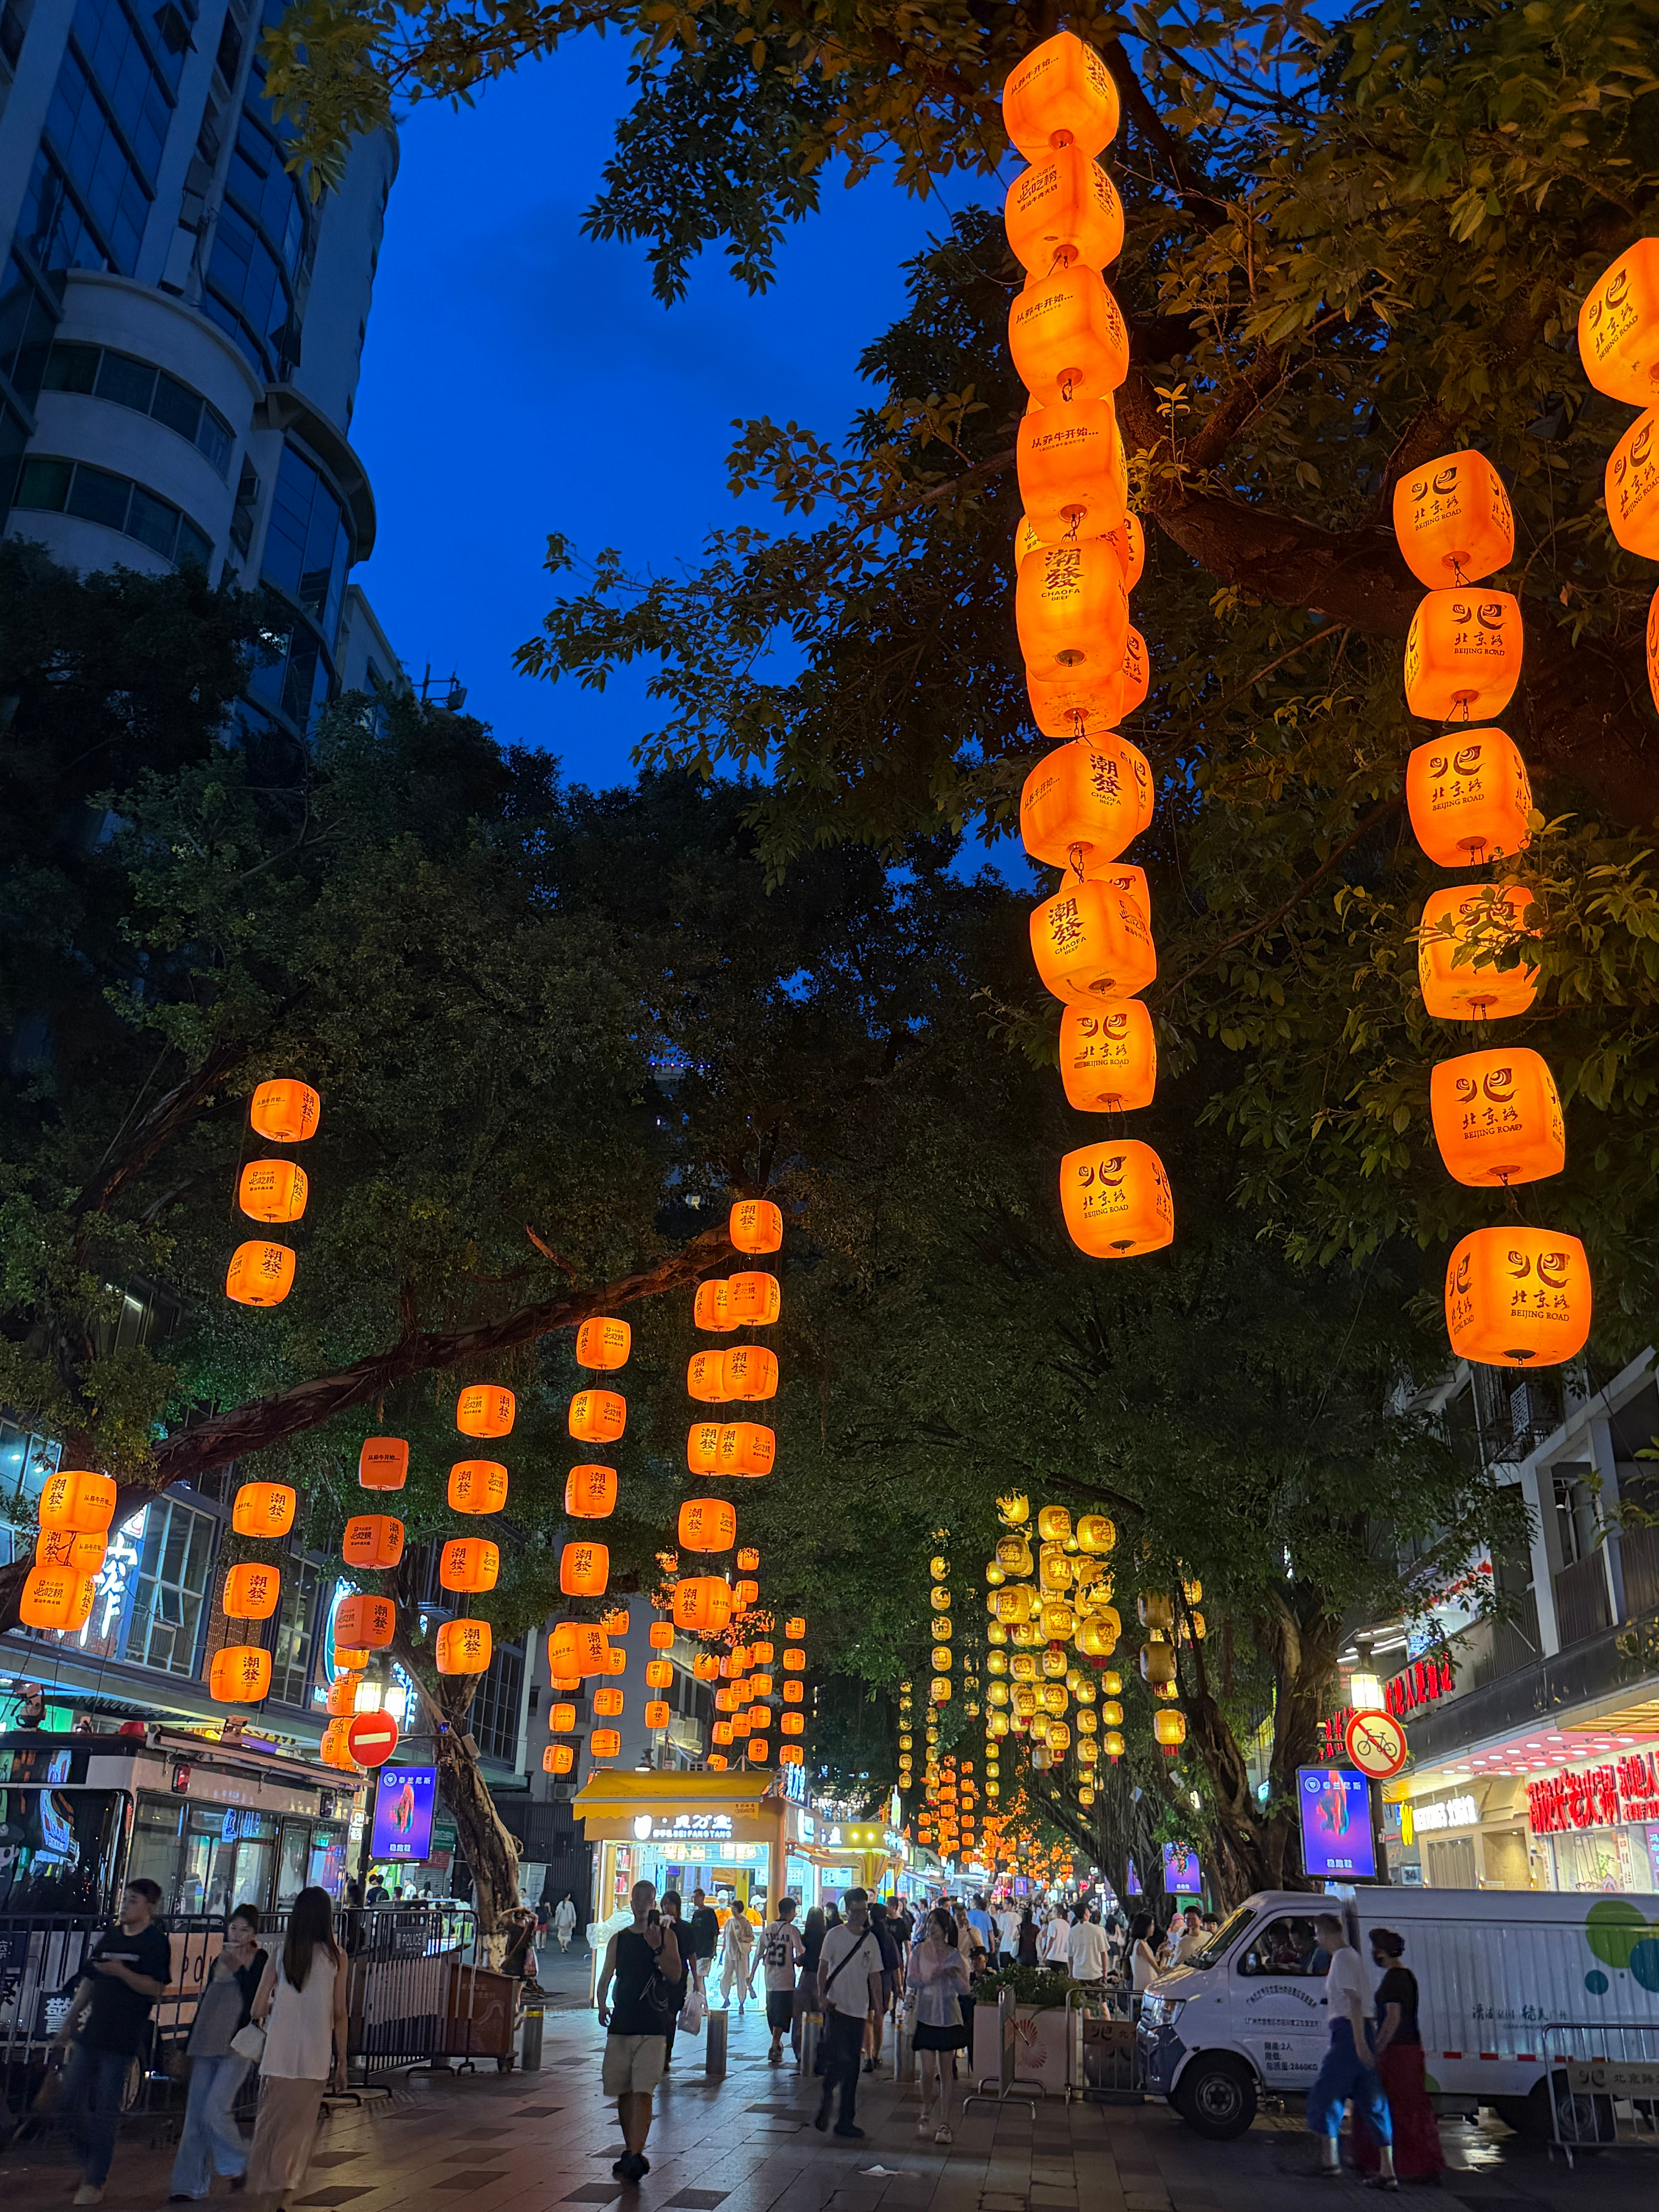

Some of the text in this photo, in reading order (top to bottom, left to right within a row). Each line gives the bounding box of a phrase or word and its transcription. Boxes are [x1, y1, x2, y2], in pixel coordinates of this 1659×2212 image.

[1017, 170, 1057, 204] 必吃榜
[1596, 302, 1633, 354] 北京路
[1598, 314, 1638, 361] BEIJING ROAD
[1620, 461, 1656, 514] 北京路
[1414, 495, 1459, 524] 北京路
[1623, 493, 1642, 521] BEIJING
[1415, 508, 1462, 531] BEIJING ROAD
[1042, 548, 1085, 590] 潮發
[1041, 589, 1080, 598] CHAOFA
[1454, 631, 1503, 647] 北京路
[1090, 753, 1123, 797] 潮發
[1091, 792, 1121, 805] CHAOFA
[1432, 778, 1483, 803] 北京路
[1432, 794, 1484, 811] BEIJING ROAD
[1048, 898, 1085, 945] 潮發
[1055, 936, 1086, 955] CHAOFA
[1065, 945, 1079, 955] BEEF
[1077, 1043, 1127, 1060] 北京路
[301, 1091, 314, 1118] 潮發
[1462, 1105, 1518, 1130] 北京路
[1464, 1124, 1523, 1140] BEIJING ROAD
[1083, 1189, 1126, 1210] 北京路
[740, 1205, 756, 1225] 潮發
[1084, 1208, 1108, 1219] BEIJING
[261, 1247, 282, 1274] 潮發
[1511, 1289, 1570, 1310] 北京路
[1510, 1309, 1570, 1322] BEIJING ROAD
[694, 1357, 705, 1378] 潮發
[731, 1352, 748, 1374] 潮發
[498, 1395, 510, 1418] 潮發
[574, 1396, 588, 1418] 潮發
[699, 1428, 717, 1449] 潮發
[722, 1430, 736, 1453] 潮發
[48, 1479, 67, 1505] 潮發
[457, 1470, 472, 1493] 潮發
[589, 1472, 606, 1495] 潮發
[269, 1492, 285, 1517] 潮發
[687, 1508, 702, 1530] 潮發
[1051, 1513, 1069, 1530] 吃
[1092, 1522, 1110, 1538] 吃
[45, 1531, 61, 1556] 潮發
[388, 1522, 399, 1546] 潮發
[450, 1547, 466, 1570] 潮發
[574, 1549, 592, 1572] 潮發
[1049, 1559, 1070, 1578] 乳
[34, 1587, 63, 1598] 必吃榜
[82, 1580, 93, 1609] 潮發
[248, 1575, 268, 1600] 潮發
[682, 1589, 697, 1612] 潮發
[373, 1604, 388, 1629] 潮發
[463, 1628, 481, 1652] 潮發
[588, 1632, 602, 1656] 潮發
[242, 1656, 261, 1681] 潮發
[1044, 1655, 1057, 1667] 大
[1323, 1782, 1361, 1790] 泰兰尼斯
[402, 1933, 421, 1946] POLICE
